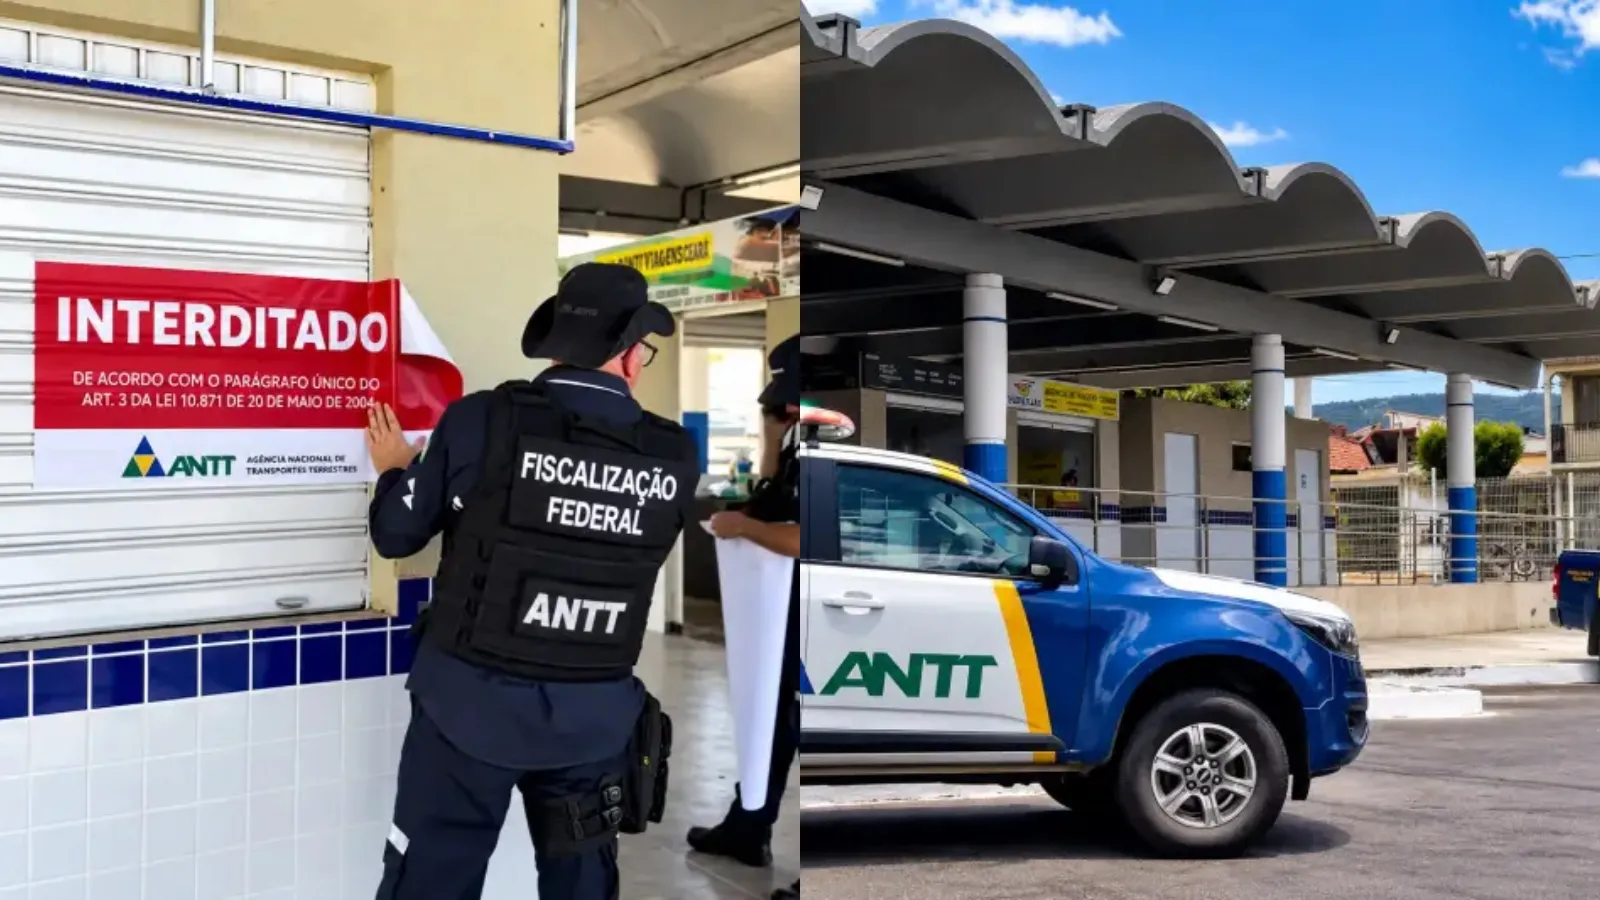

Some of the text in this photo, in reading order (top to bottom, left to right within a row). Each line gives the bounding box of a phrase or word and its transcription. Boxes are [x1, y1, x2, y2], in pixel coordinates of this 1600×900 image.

[57, 296, 388, 353] INTERDITADO
[73, 371, 380, 390] DE ACORDO COM O PARÁGRAFO ÚNICO DO
[82, 393, 115, 407] ART.
[119, 393, 127, 407] 3
[130, 393, 152, 407] DA
[156, 394, 176, 407] LEI
[181, 394, 222, 408] 10.871
[226, 395, 244, 408] DE
[247, 395, 264, 408] 20
[267, 395, 283, 408] DE
[287, 396, 323, 409] MAIO
[326, 396, 342, 409] DE
[166, 455, 237, 477] ANTT
[246, 454, 346, 465] AGÊNCIA NACIONAL DE
[246, 465, 358, 475] TRANSPORTES TERRESTRES
[520, 451, 678, 506] FISCALIZAÇÃO
[546, 496, 644, 536] FEDERAL
[522, 592, 627, 635] ANTT
[819, 651, 998, 698] ANTT
